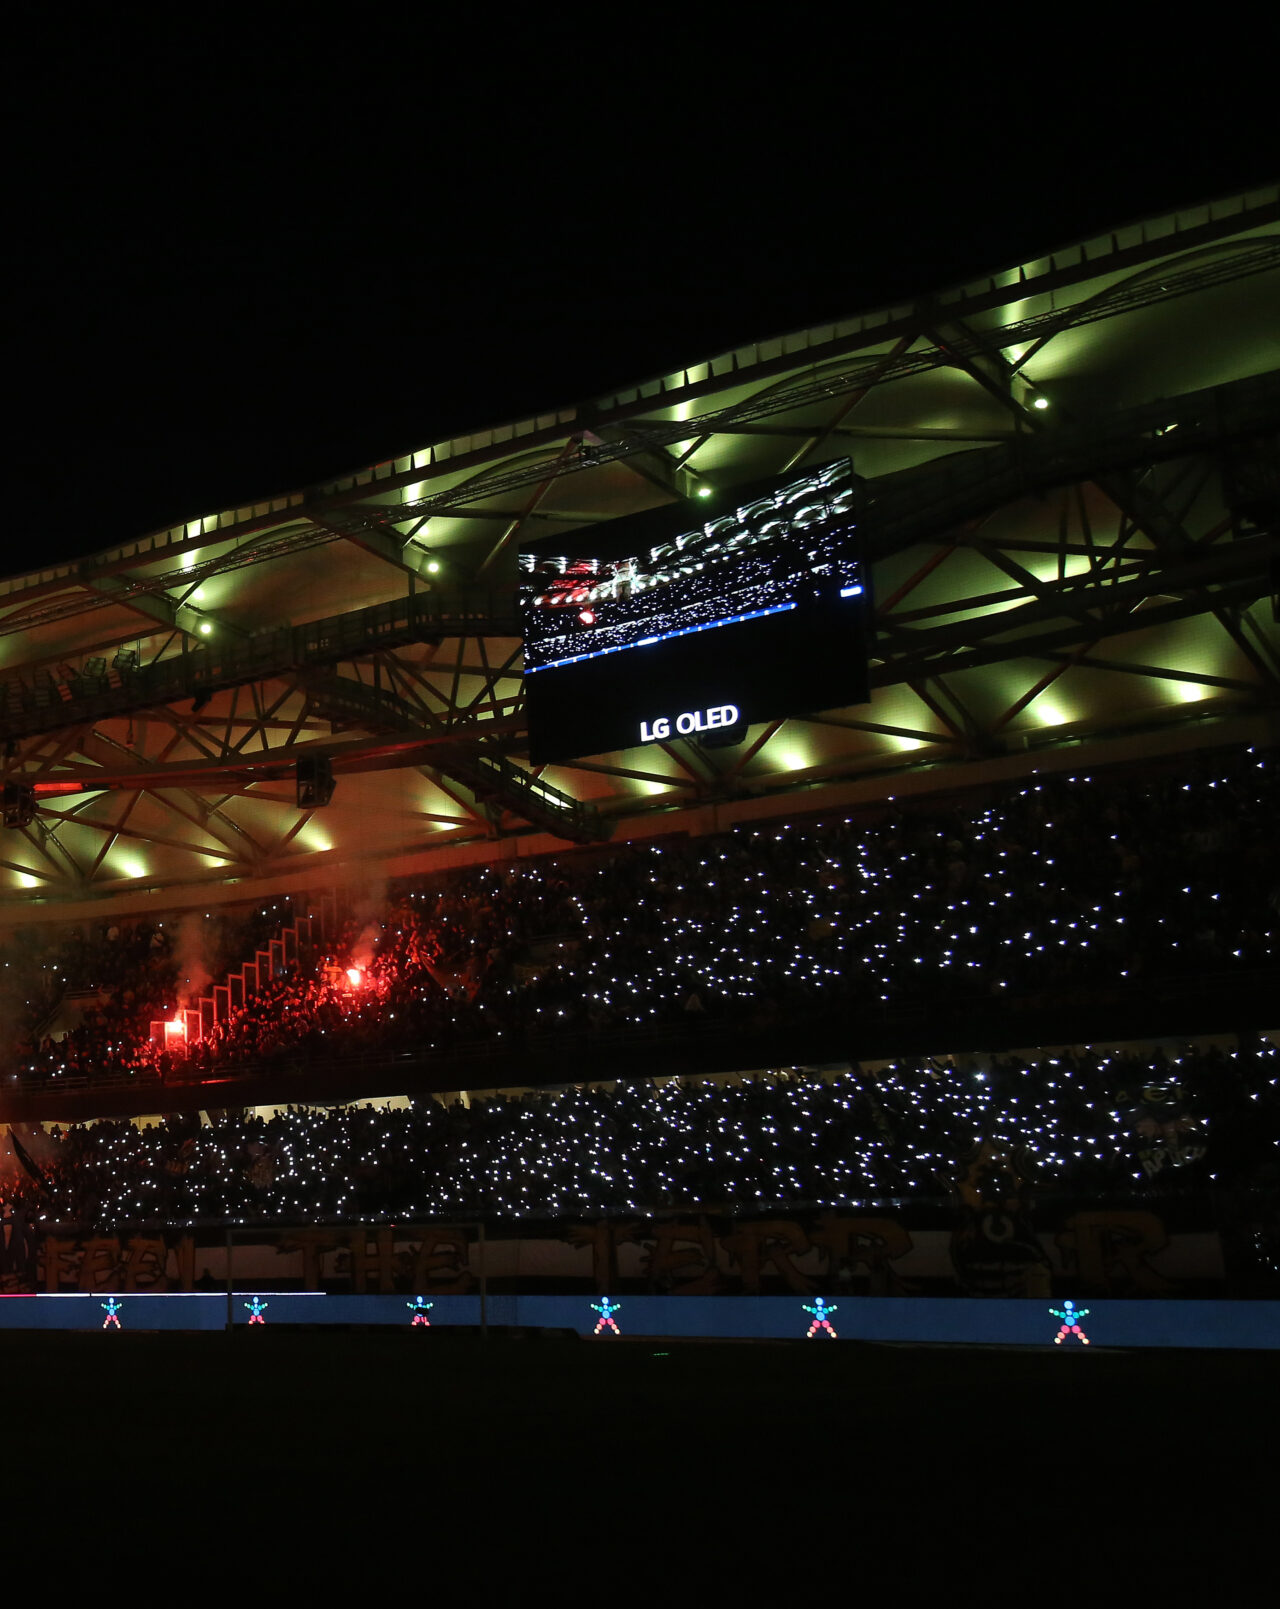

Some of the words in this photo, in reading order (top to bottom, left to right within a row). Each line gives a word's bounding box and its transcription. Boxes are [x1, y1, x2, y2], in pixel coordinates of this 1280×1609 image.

[640, 717, 670, 741] LG
[676, 704, 738, 734] OLED
[277, 1228, 472, 1293] THE
